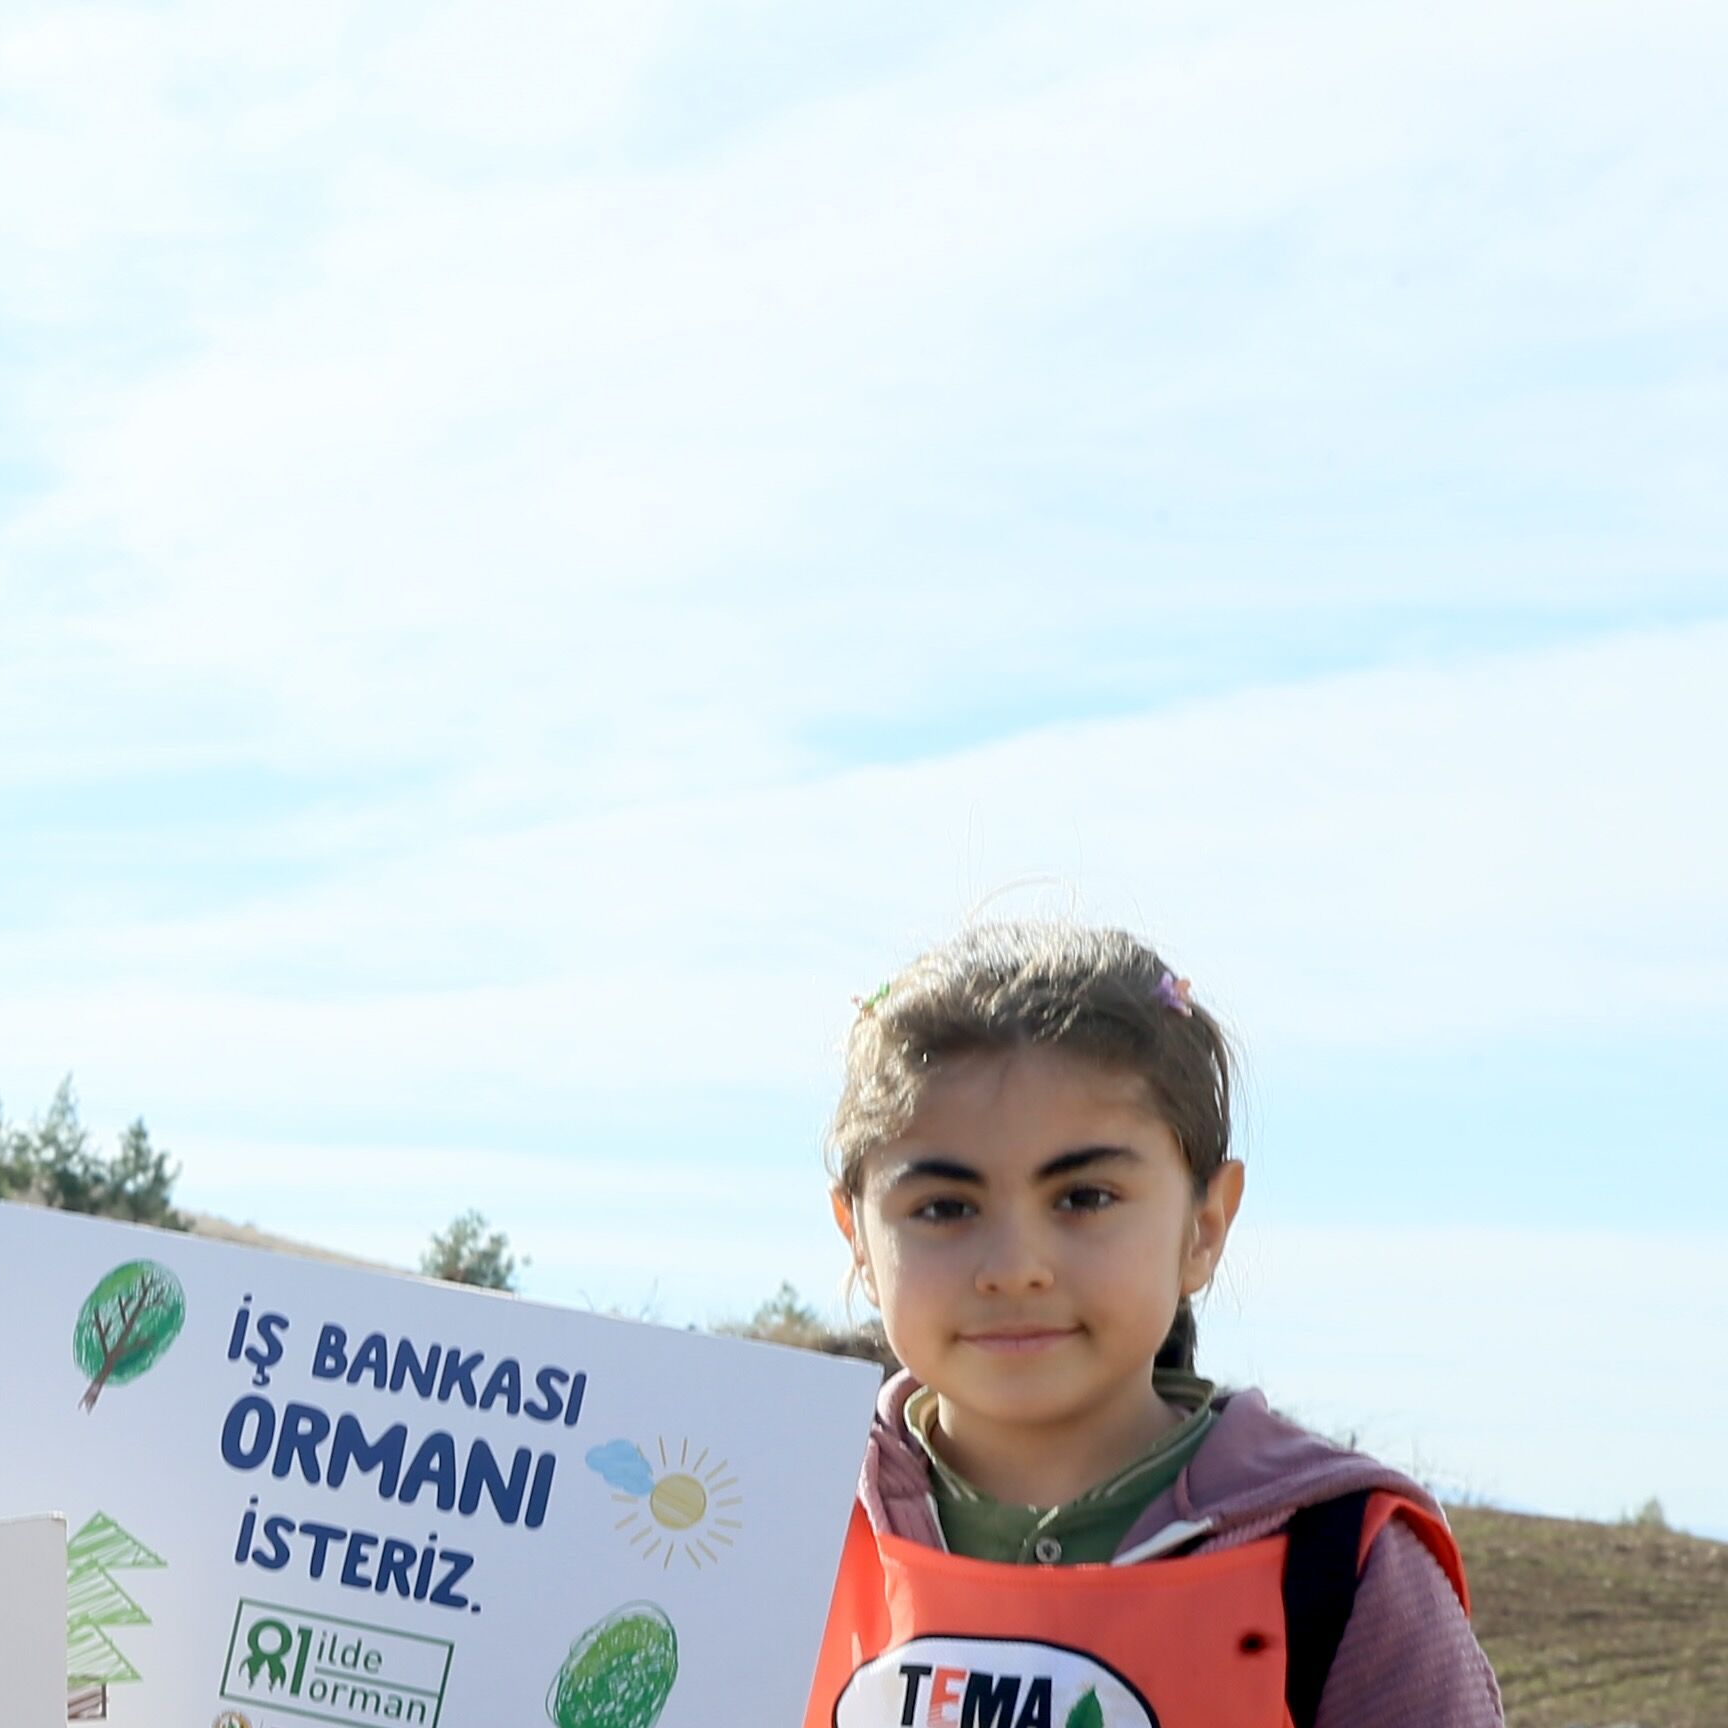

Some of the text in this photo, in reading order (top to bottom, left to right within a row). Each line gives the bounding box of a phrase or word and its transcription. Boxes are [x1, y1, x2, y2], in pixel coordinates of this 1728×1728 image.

[228, 1293, 587, 1427] İŞ BANKASI
[221, 1395, 557, 1529] ORMANI
[235, 1494, 482, 1614] İSTERİZ.
[239, 1616, 383, 1698] 81 ilde
[309, 1678, 427, 1726] orman
